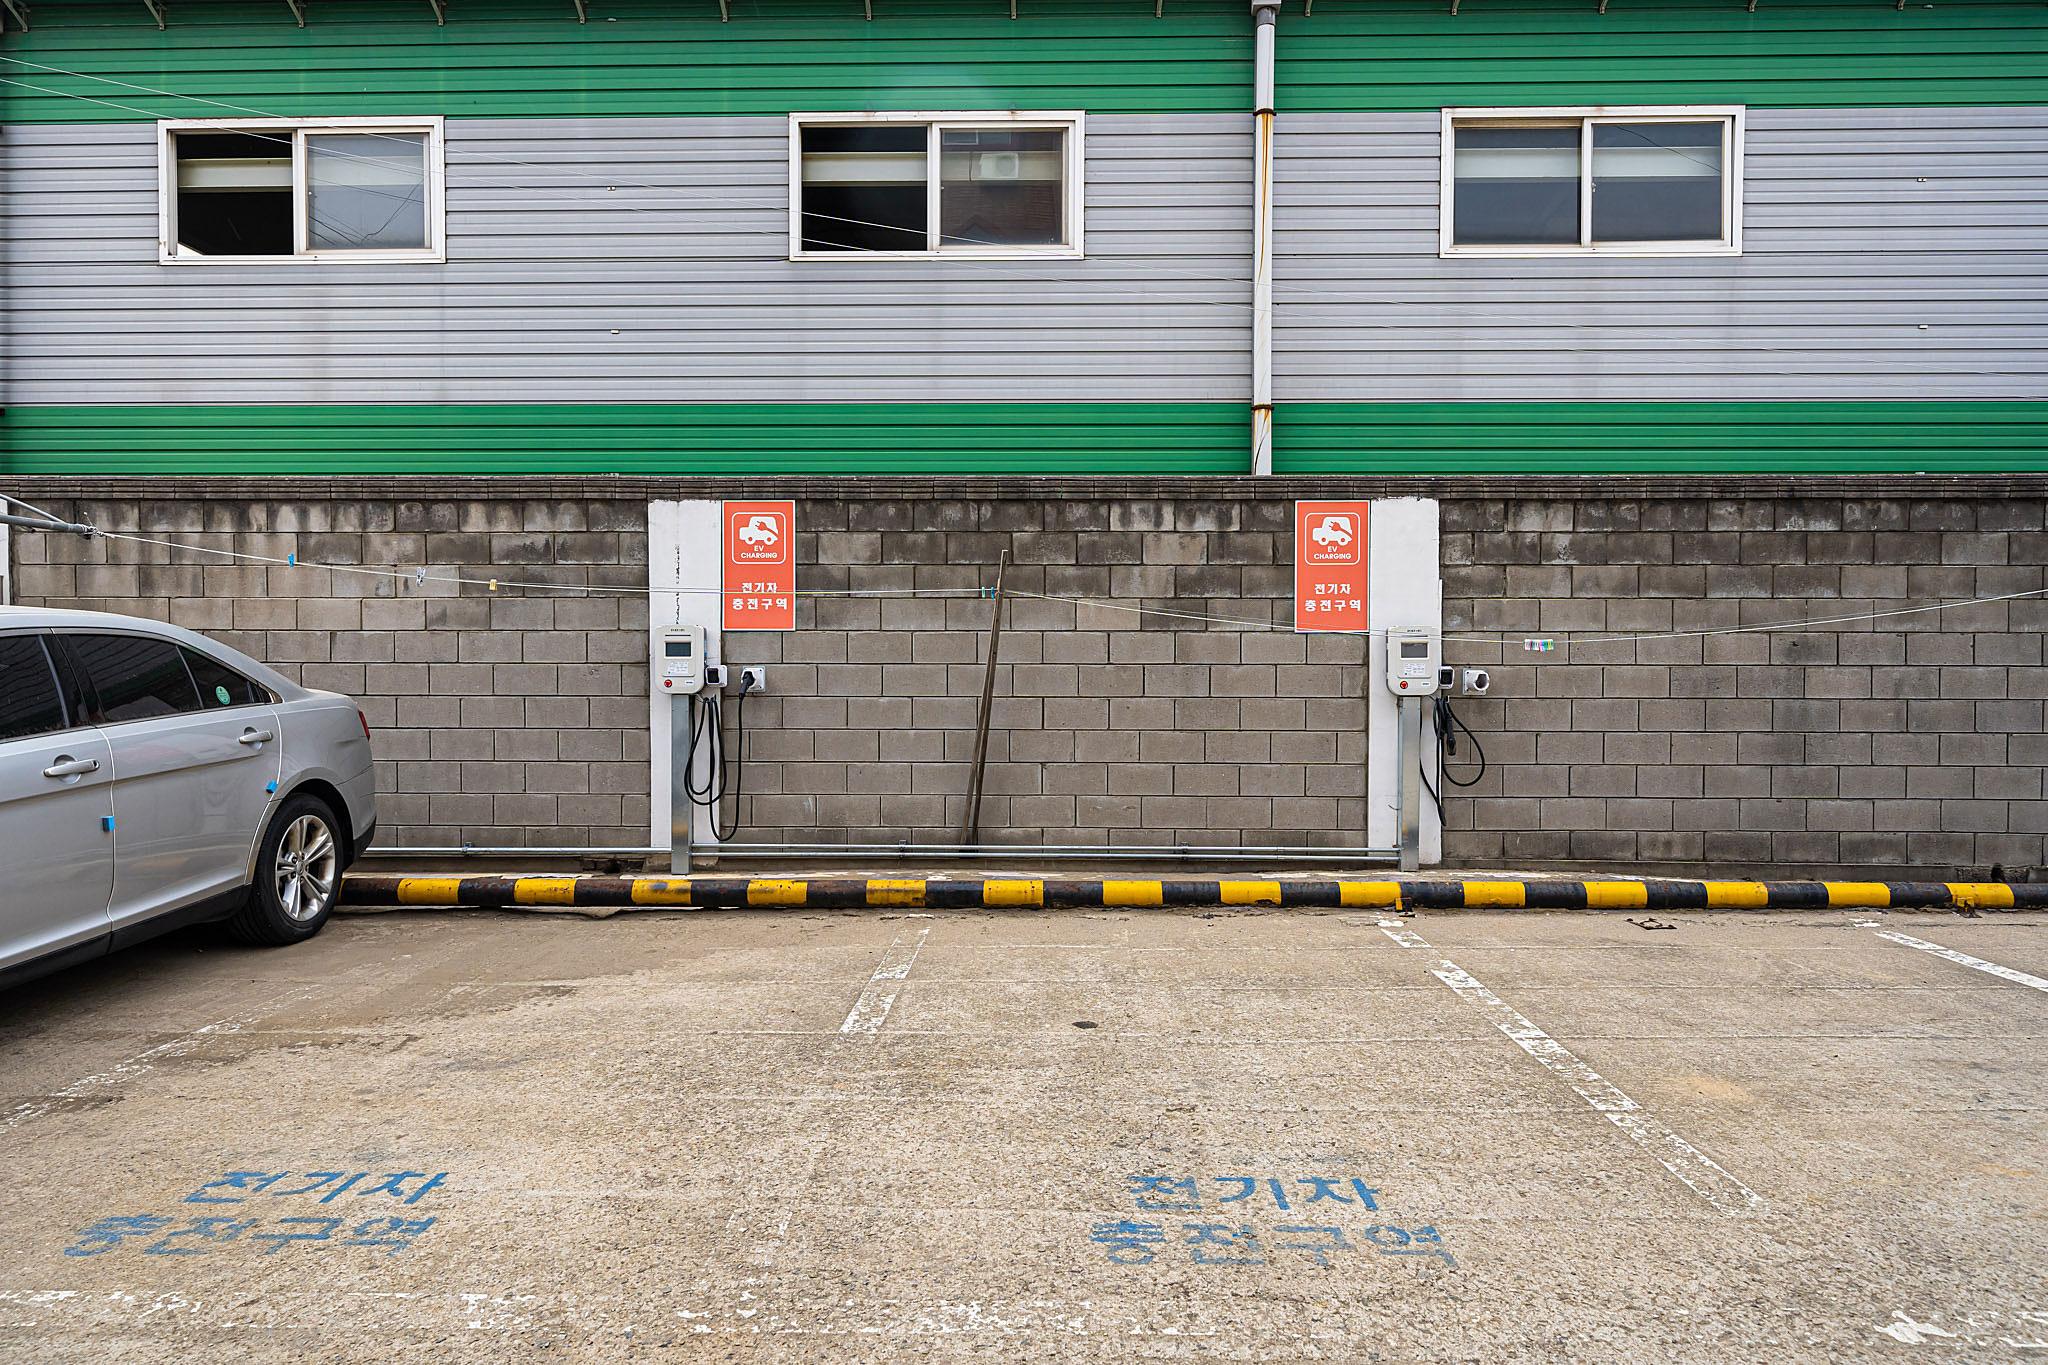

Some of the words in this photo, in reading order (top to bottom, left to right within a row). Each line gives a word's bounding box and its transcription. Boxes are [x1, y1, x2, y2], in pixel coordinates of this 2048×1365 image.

[732, 598, 788, 610] 충전구역
[1304, 599, 1361, 612] 충전구역
[182, 1170, 449, 1205] 전기차
[1126, 1174, 1380, 1211] 전기차
[63, 1212, 440, 1258] 충전구역
[1088, 1219, 1458, 1268] 충전구역
